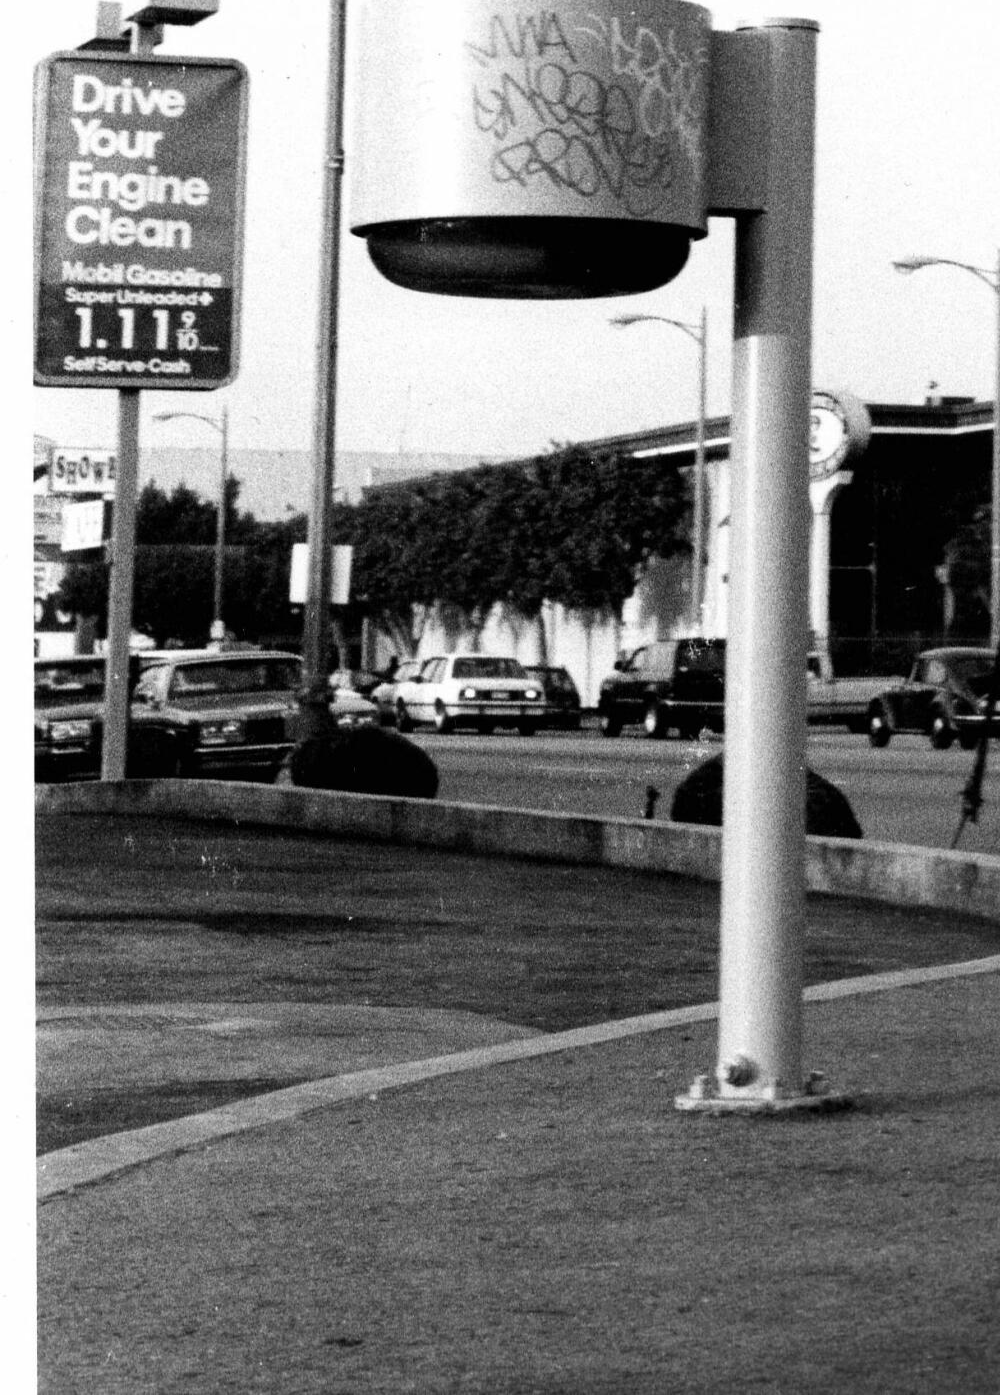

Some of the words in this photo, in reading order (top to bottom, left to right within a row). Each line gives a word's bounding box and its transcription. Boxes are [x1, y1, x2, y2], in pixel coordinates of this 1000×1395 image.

[72, 73, 186, 118] Drive
[70, 117, 164, 159] Your
[67, 161, 210, 211] Engine
[65, 205, 192, 250] Clean
[61, 260, 125, 284] Mobil
[126, 263, 222, 288] Gasoline
[74, 306, 169, 350] 1.11
